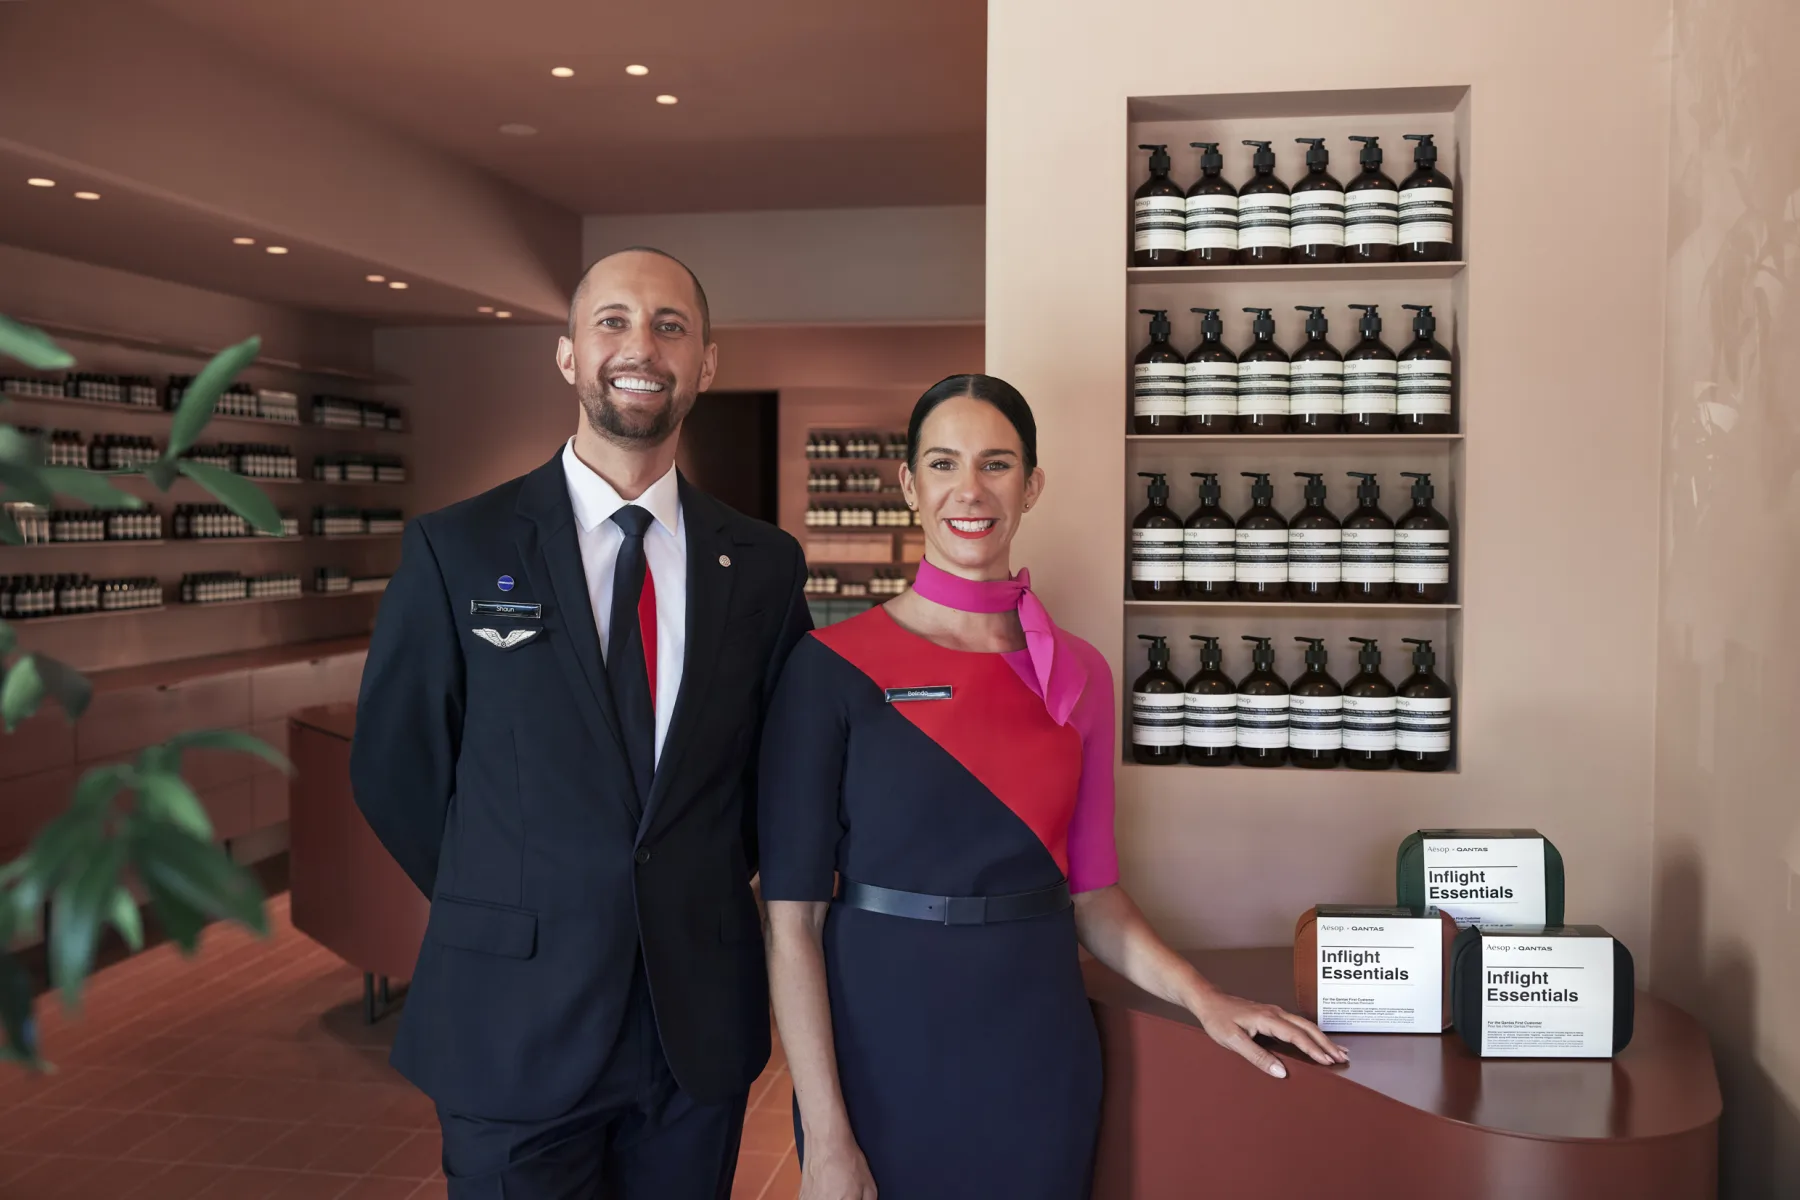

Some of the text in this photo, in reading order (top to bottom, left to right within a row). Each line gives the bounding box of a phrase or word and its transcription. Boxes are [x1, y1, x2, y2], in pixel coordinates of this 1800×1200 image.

[1429, 870, 1486, 886] Inflight
[1429, 886, 1514, 899] Essentials
[1322, 950, 1381, 966] Inflight
[1322, 966, 1409, 981] Essentials
[1487, 971, 1549, 988] Inflight
[1487, 988, 1579, 1002] Essentials
